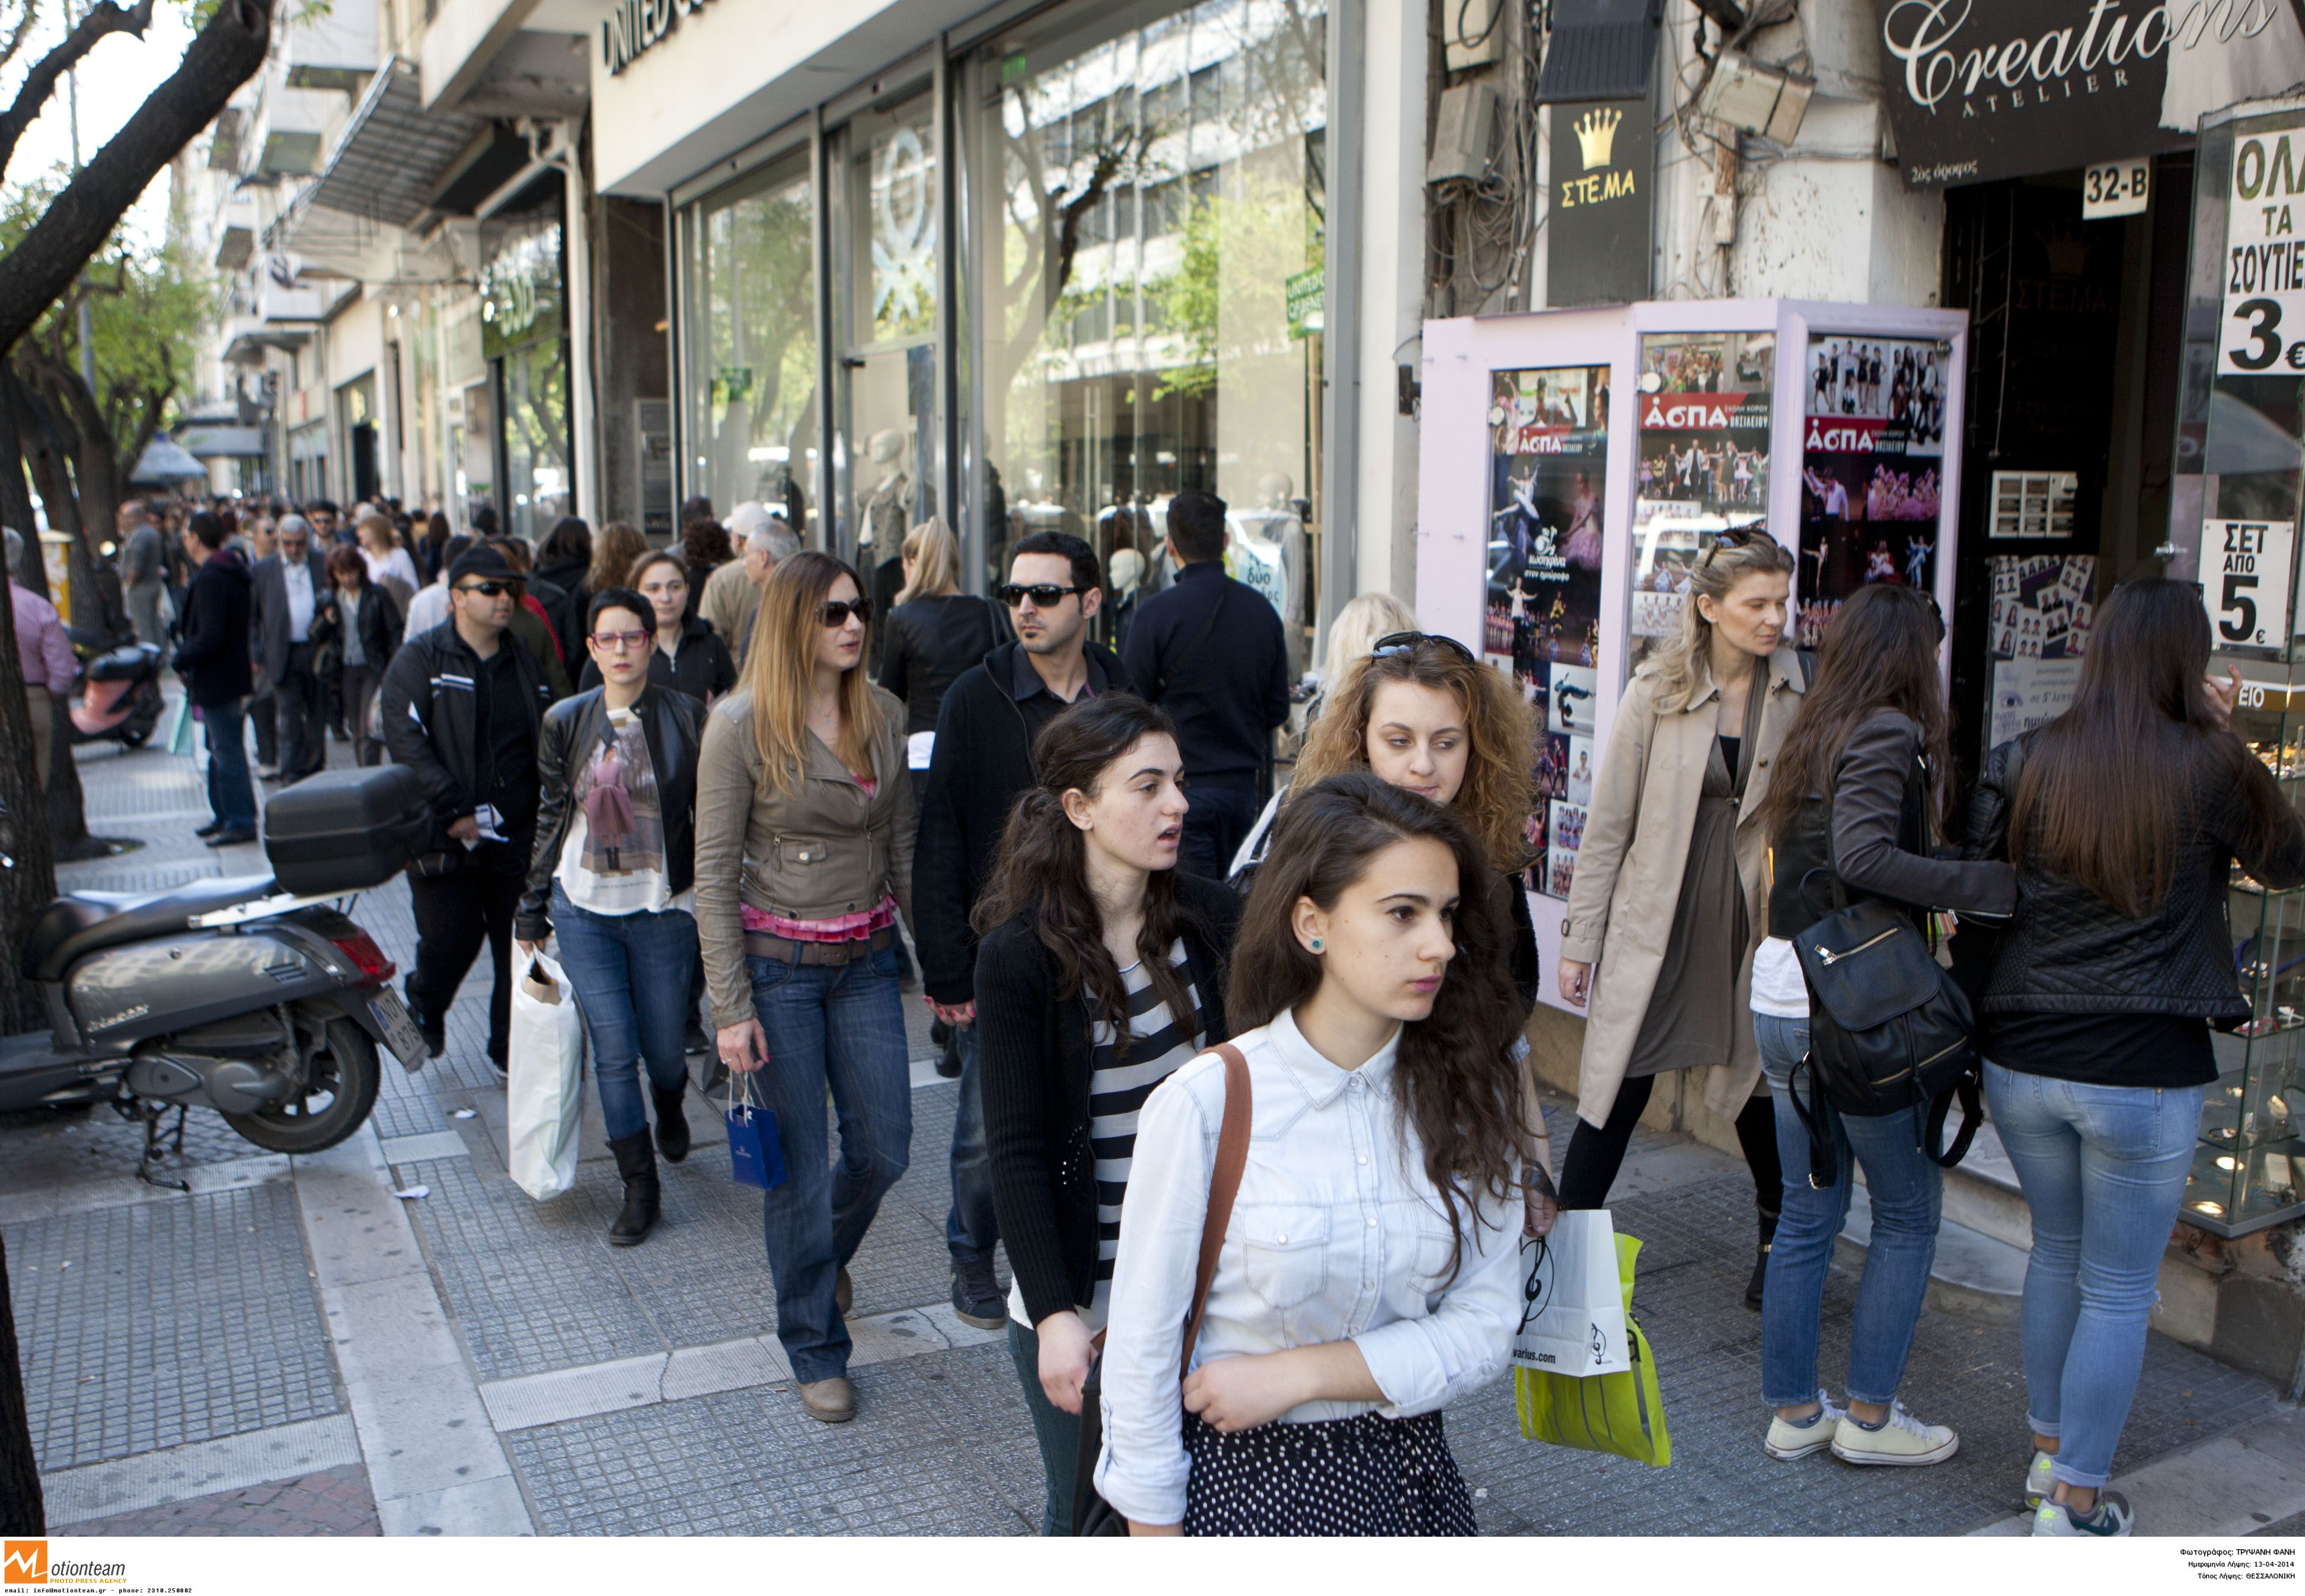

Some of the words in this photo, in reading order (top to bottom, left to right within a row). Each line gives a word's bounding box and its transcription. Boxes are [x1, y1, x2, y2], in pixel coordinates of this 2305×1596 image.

[1885, 0, 2276, 116] Creations
[1962, 69, 2130, 117] ATELIER
[1561, 168, 1635, 208] ΣΤΕ.ΜΑ
[2086, 166, 2147, 205] 32-B
[2262, 205, 2293, 236] ΤΑ
[2224, 523, 2269, 554] ΣΕΤ
[2223, 554, 2255, 573] ΑΠΟ
